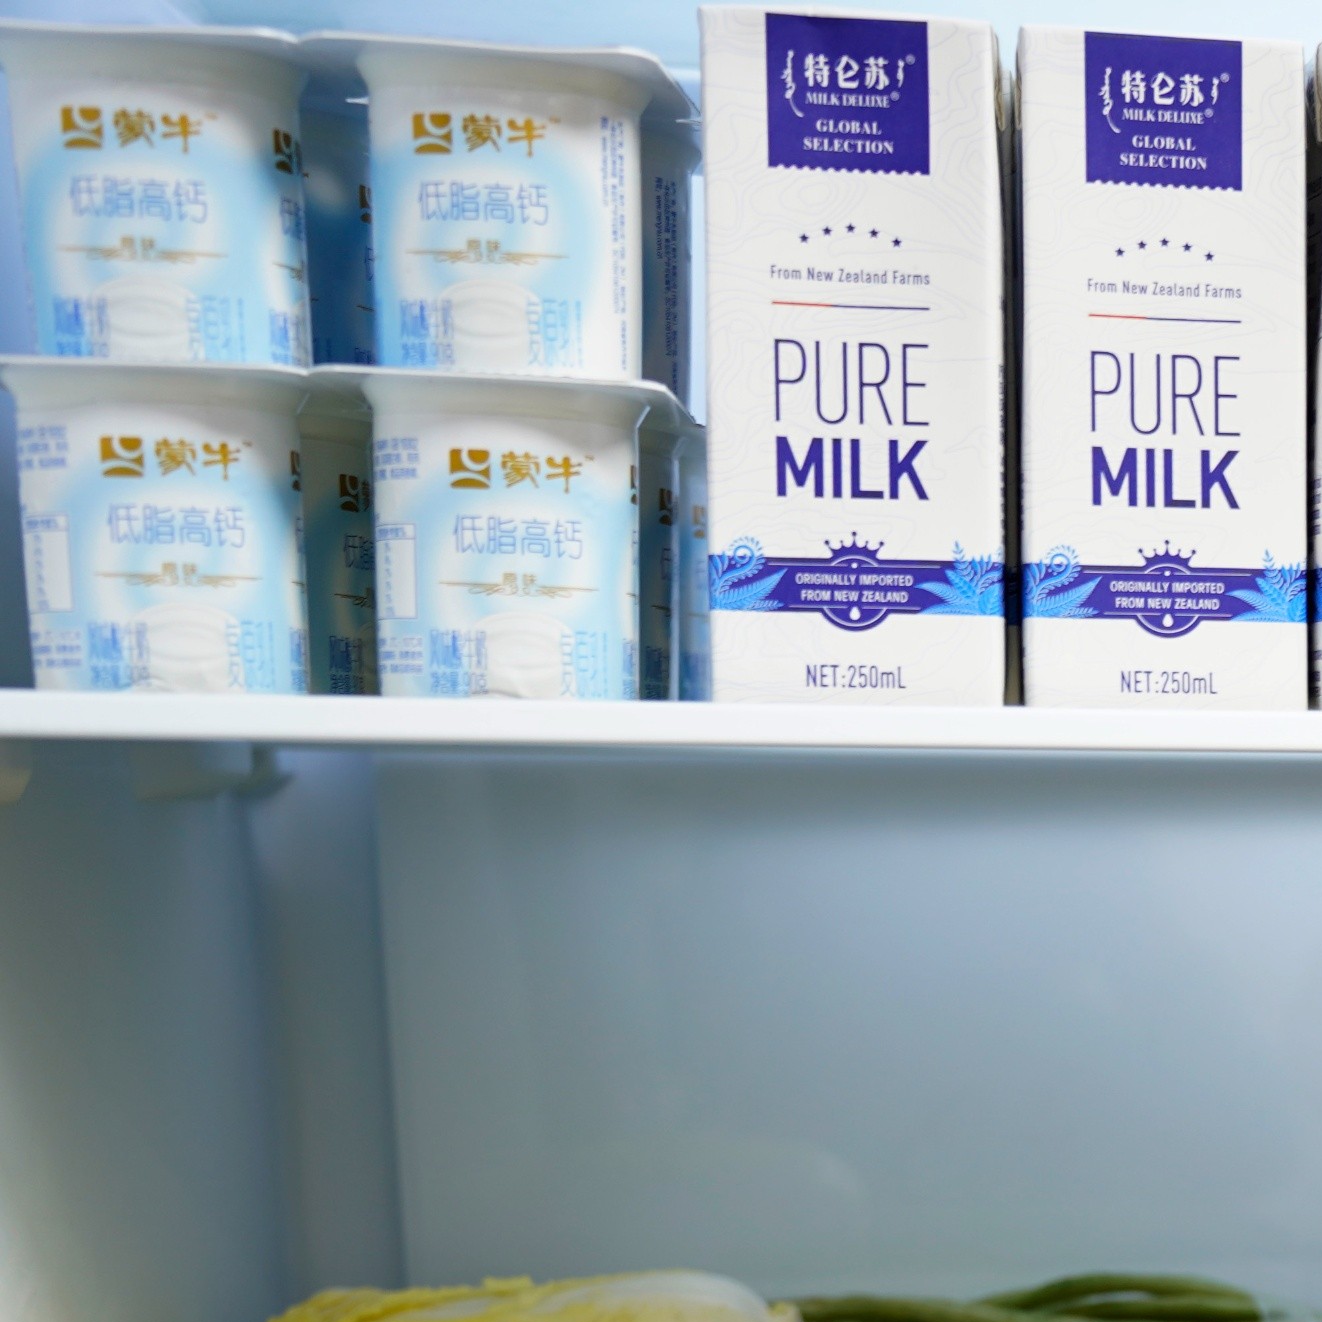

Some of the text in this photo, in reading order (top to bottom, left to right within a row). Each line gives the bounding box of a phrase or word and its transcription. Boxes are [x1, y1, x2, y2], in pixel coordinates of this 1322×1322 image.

[804, 53, 890, 90] 特仑苏
[805, 92, 890, 108] MILK DELUXE
[1121, 70, 1205, 107] 特仑苏
[112, 108, 201, 154] 蒙牛
[816, 119, 882, 135] GLOBAL
[1122, 108, 1205, 125] MILK DELUXE
[462, 114, 546, 158] 蒙牛
[803, 137, 894, 154] SELECTION
[1131, 135, 1196, 151] GLOBAL
[1119, 153, 1207, 170] SELECTION
[69, 173, 209, 224] 低脂高钙
[418, 180, 549, 226] 低脂高钙
[770, 265, 930, 286] From New Zealand Farms
[1087, 278, 1242, 299] From New Zealand Farms
[774, 339, 930, 427] PURE
[1091, 350, 1241, 437] PURE
[155, 438, 241, 481] 蒙牛
[501, 452, 582, 494] 蒙牛
[775, 436, 930, 500] MILK
[1091, 446, 1240, 509] MILK
[106, 503, 246, 548] 低脂高钙
[453, 513, 583, 560] 低脂高钙
[795, 573, 913, 588] ORIGINALLY IMPORTED
[1110, 580, 1225, 595] ORIGINALLY IMPORTED
[801, 590, 909, 604] FROM NEW ZEALAND
[1115, 597, 1220, 611] FROM NEW ZEALAND
[806, 664, 907, 690] NET:250mL
[1120, 670, 1218, 695] NET:250mL
